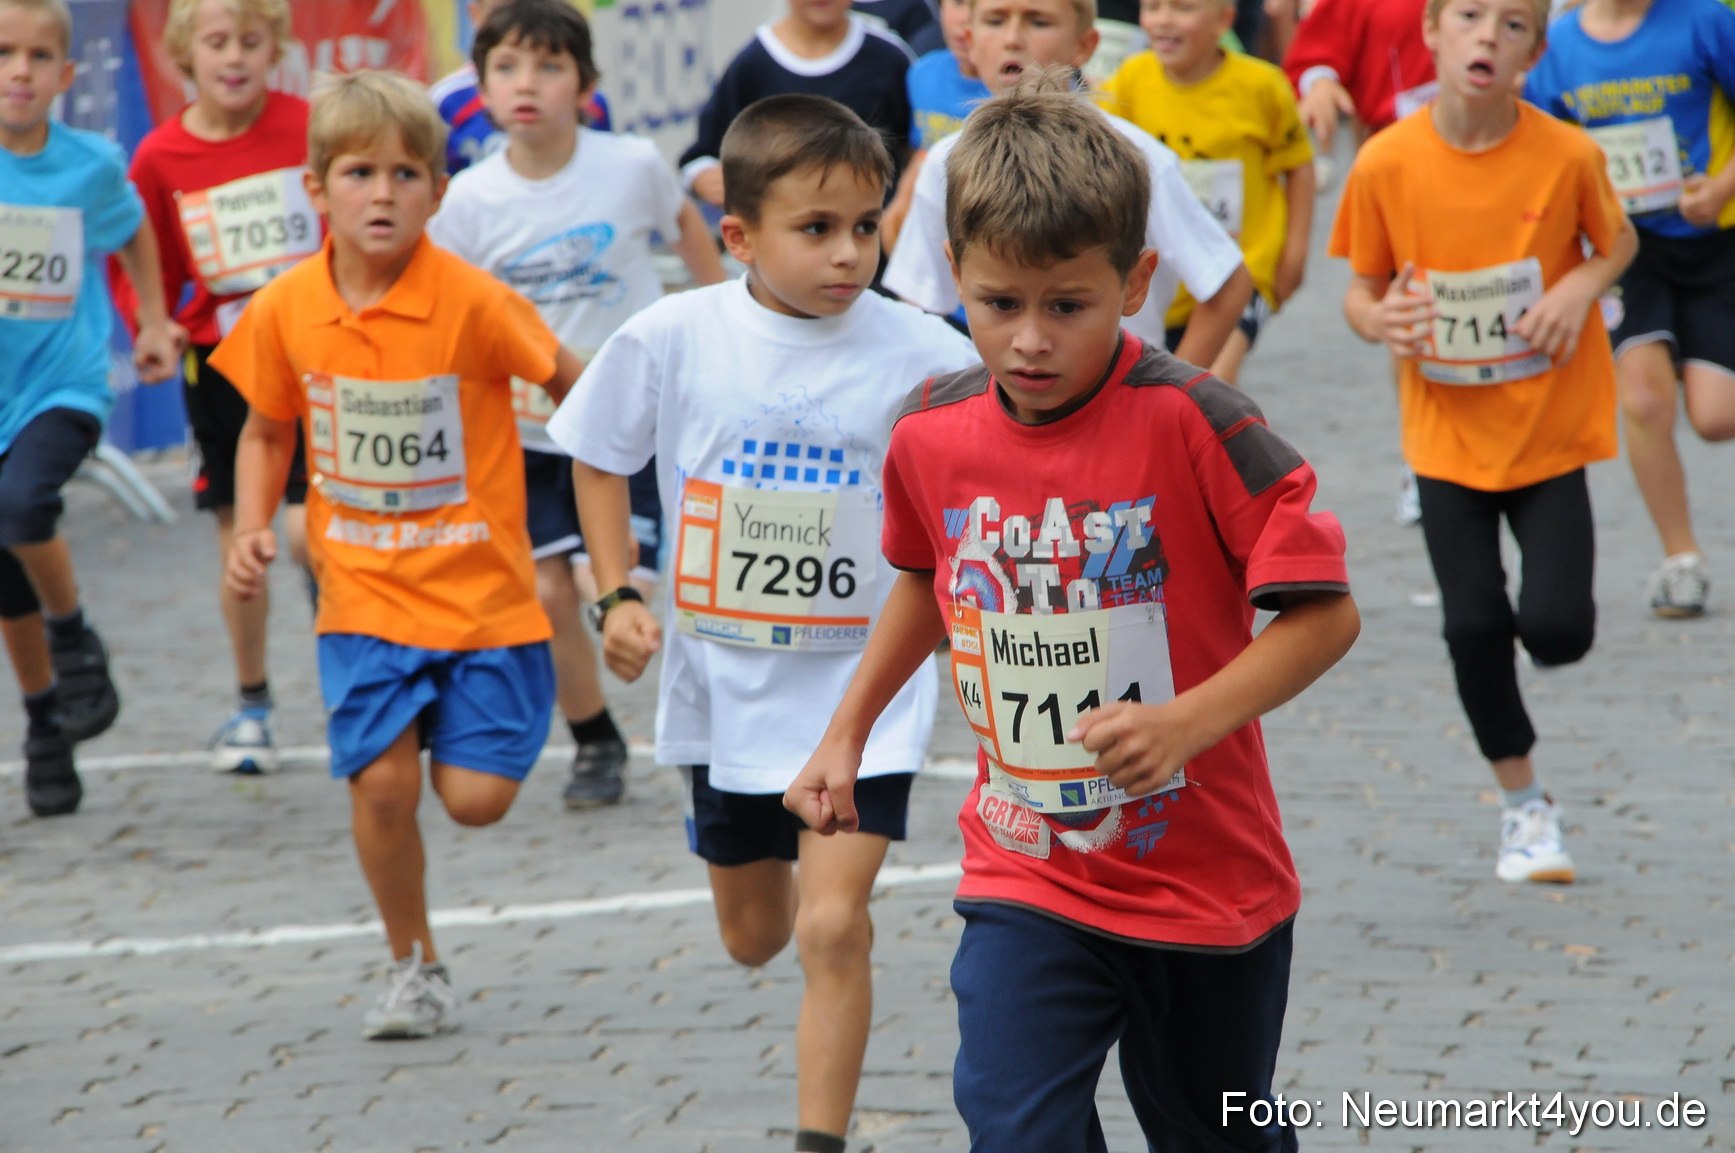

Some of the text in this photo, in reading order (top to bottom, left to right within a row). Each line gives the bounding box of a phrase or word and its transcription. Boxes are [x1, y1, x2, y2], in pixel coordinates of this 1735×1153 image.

[1610, 148, 1668, 182] 312
[223, 212, 309, 255] 7039
[0, 249, 67, 284] 220
[1439, 307, 1528, 344] 714
[341, 388, 443, 416] Sebastian
[347, 427, 449, 467] 7064
[397, 518, 492, 549] Reisen
[735, 502, 831, 547] Yannick
[732, 551, 856, 599] 7296
[1107, 567, 1163, 592] TEAM
[793, 626, 868, 641] PFLEIDERER
[991, 627, 1100, 667] Michael
[961, 680, 981, 708] K4
[983, 796, 1023, 829] CRT
